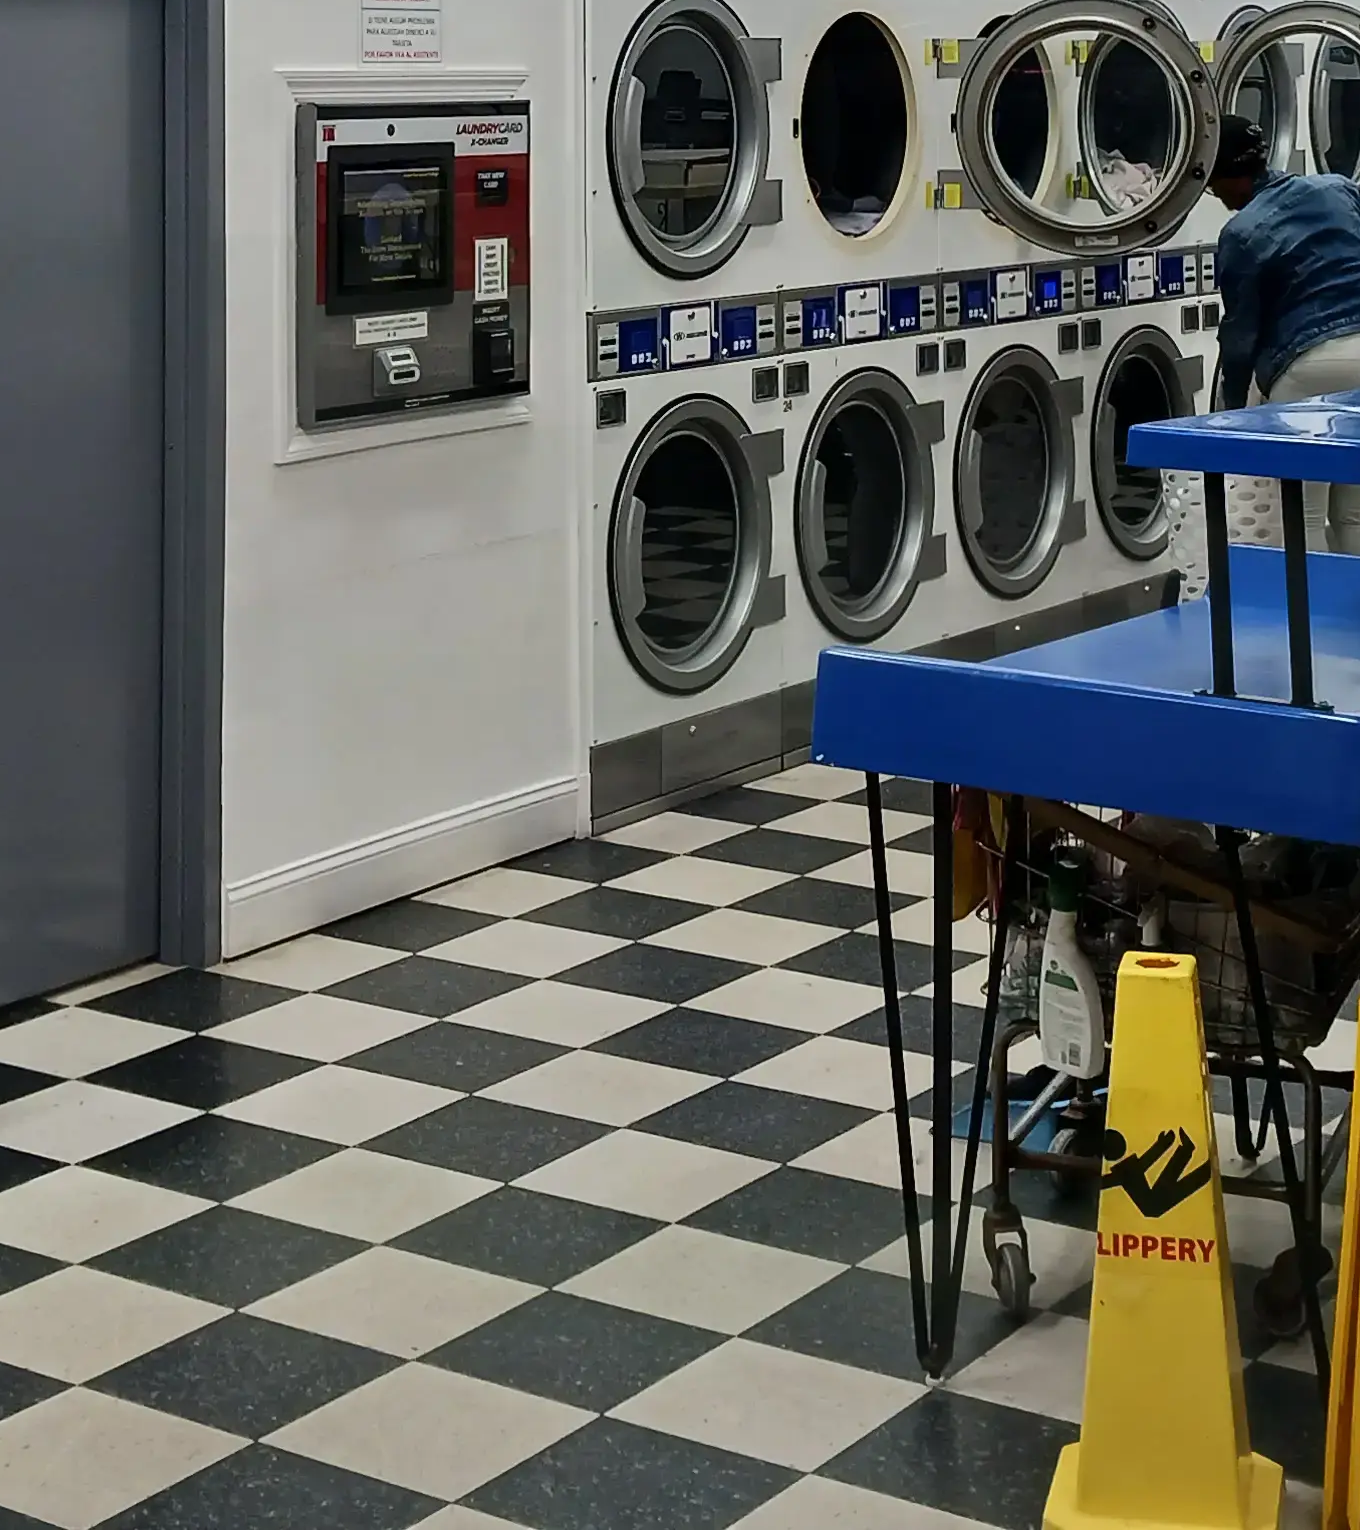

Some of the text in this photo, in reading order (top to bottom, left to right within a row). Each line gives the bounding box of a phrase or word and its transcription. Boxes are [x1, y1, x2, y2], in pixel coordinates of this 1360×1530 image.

[455, 121, 524, 136] LAUNDRYCARD
[470, 137, 510, 147] X-CHANGER
[1096, 1230, 1216, 1264] LIPPERY
